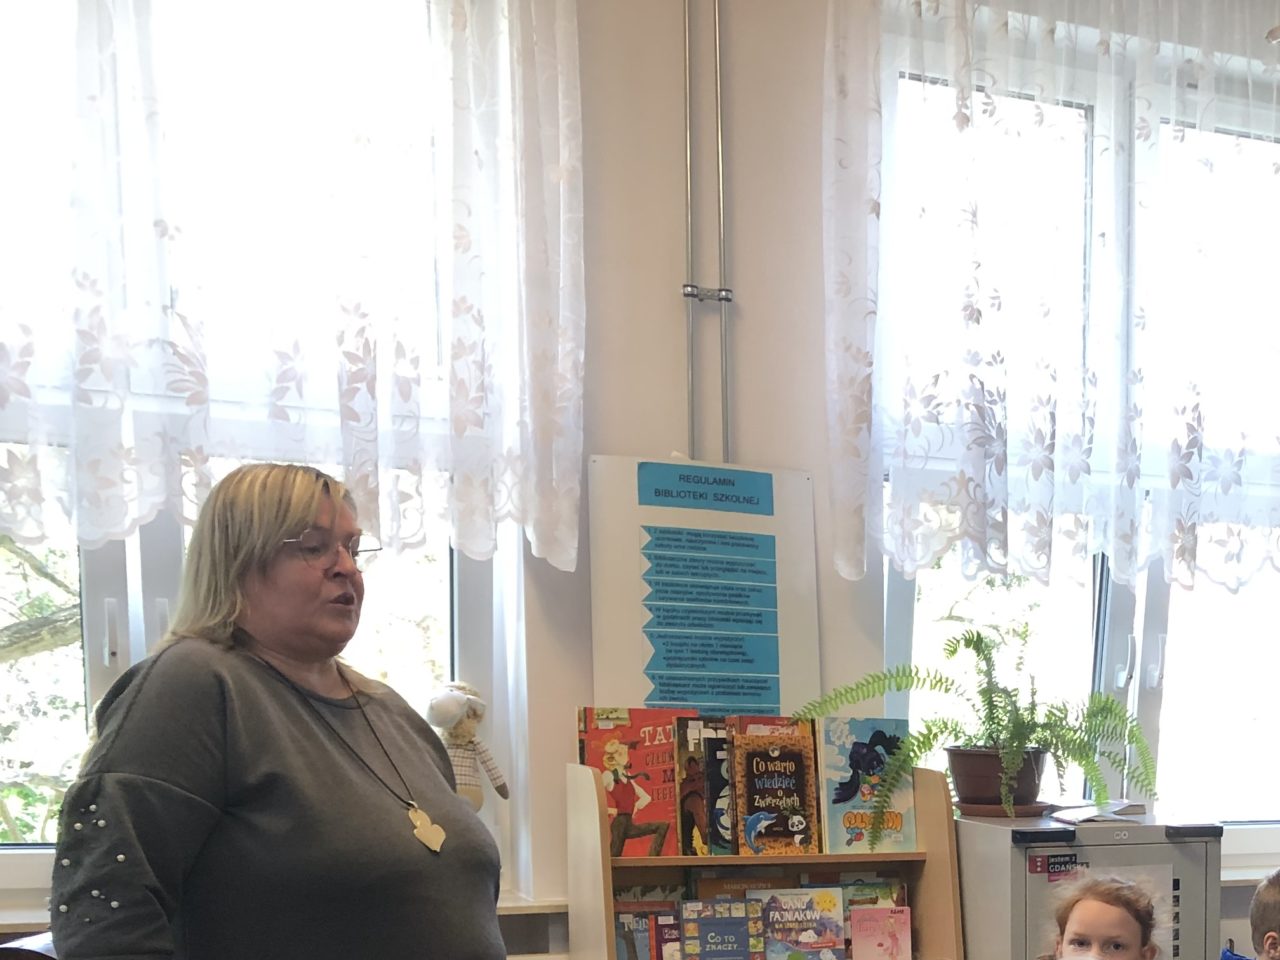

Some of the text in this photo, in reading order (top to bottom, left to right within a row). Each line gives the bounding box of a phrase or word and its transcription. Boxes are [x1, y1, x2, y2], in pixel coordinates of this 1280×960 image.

[678, 474, 735, 487] REGULAMIN
[654, 488, 760, 505] BIBLIOTEKI SZKOLNEJ
[753, 757, 796, 776] Co warto
[754, 773, 796, 790] wiedzieć
